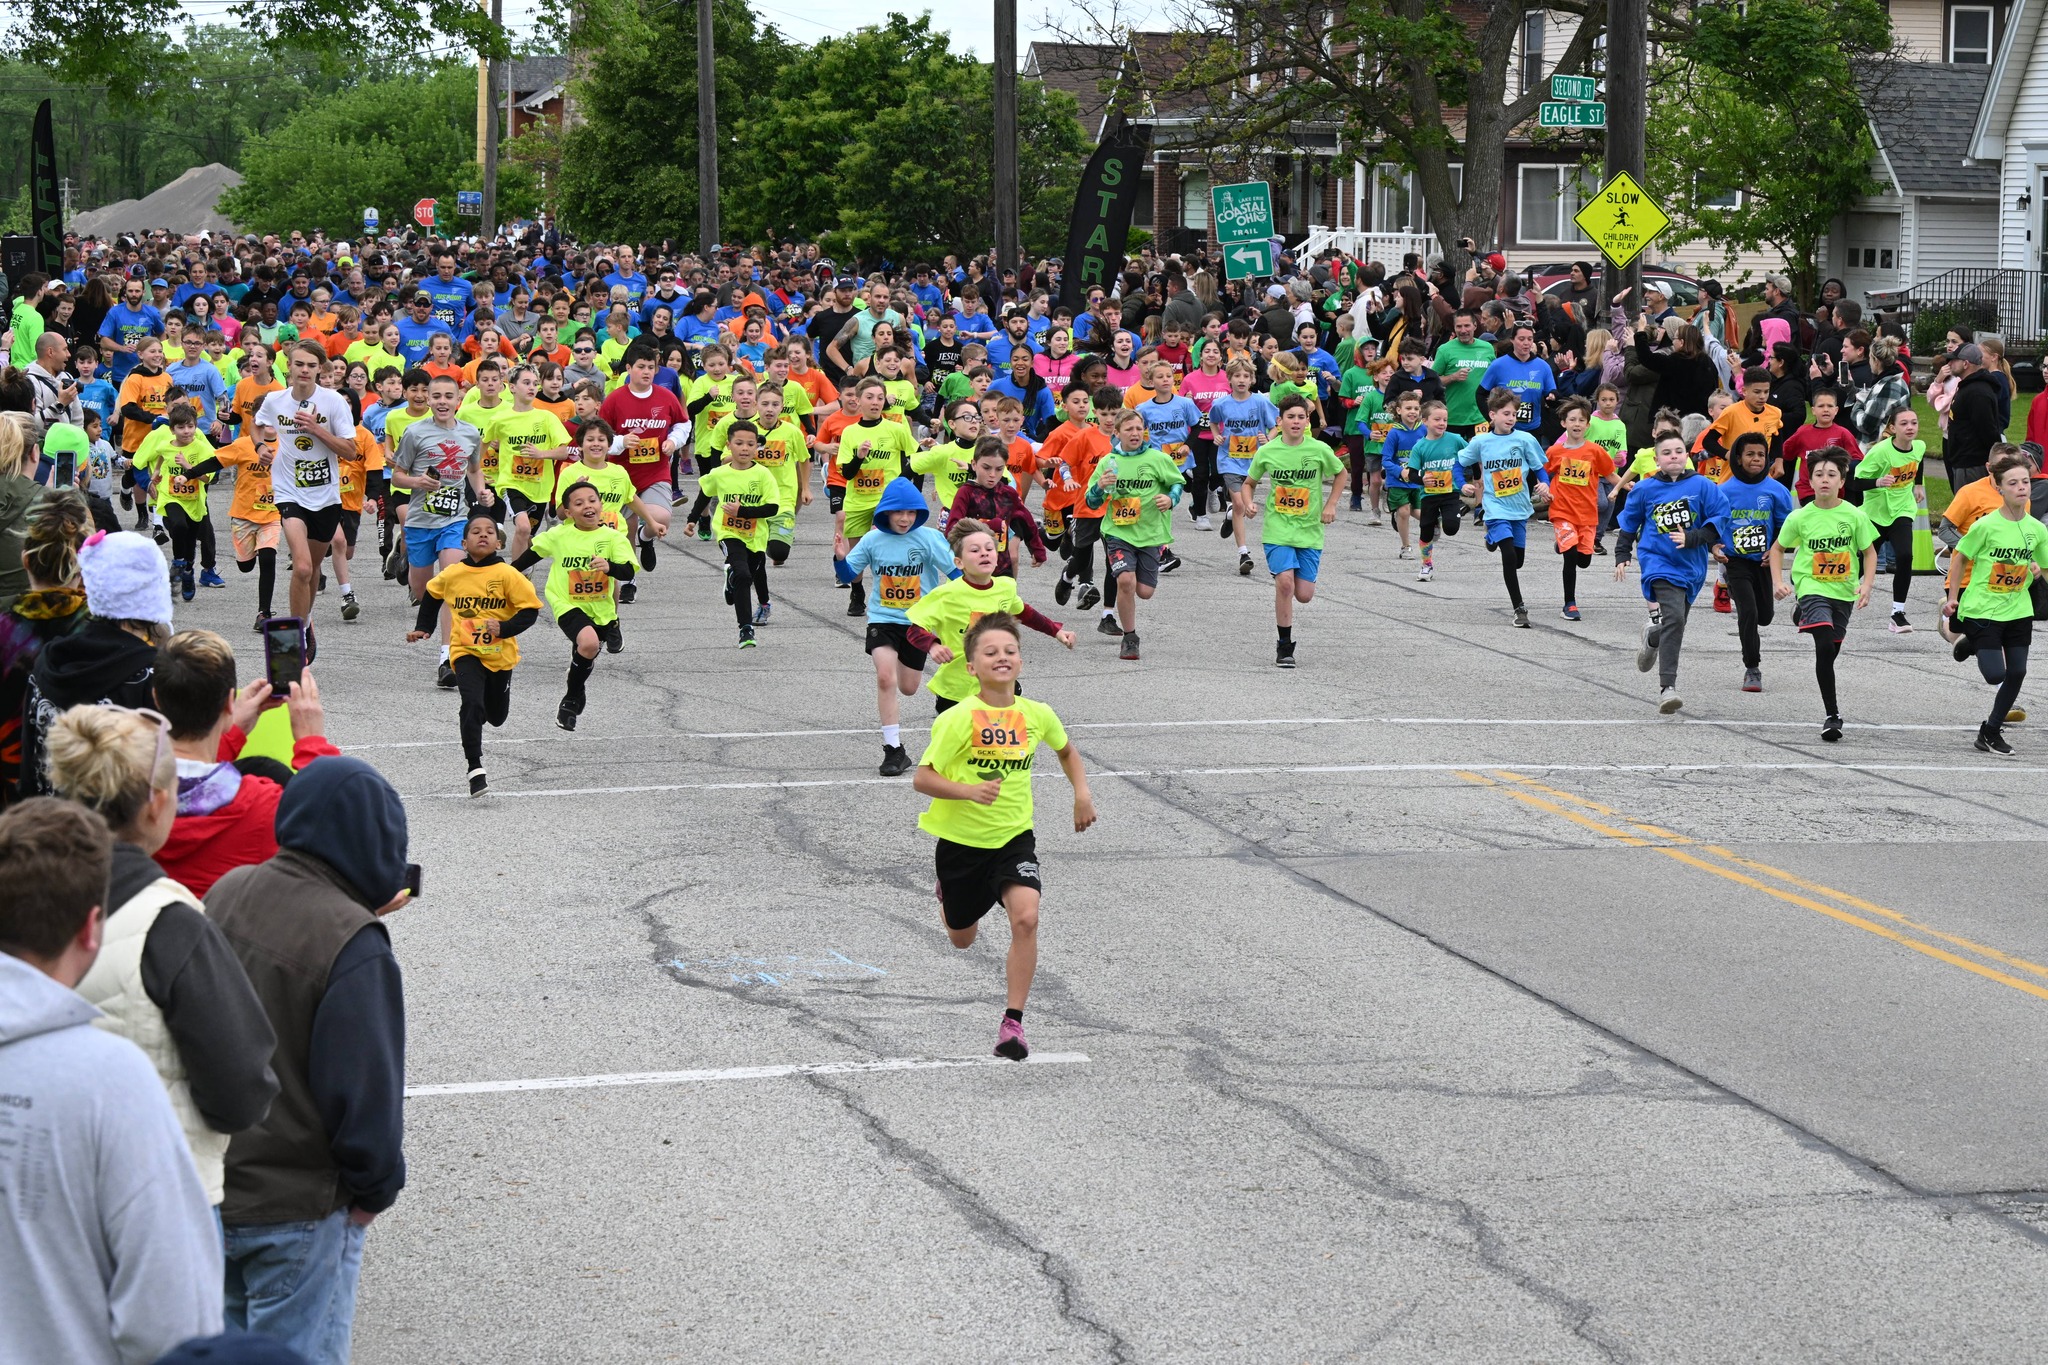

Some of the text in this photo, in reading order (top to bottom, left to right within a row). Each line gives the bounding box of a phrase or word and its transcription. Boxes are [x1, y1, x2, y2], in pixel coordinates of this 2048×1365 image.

[1555, 79, 1592, 98] SECOND ST
[1544, 106, 1600, 123] EAGLE ST
[1606, 192, 1640, 204] SLOW
[36, 142, 62, 274] TART
[416, 207, 433, 218] STO
[1217, 201, 1266, 223] COASTAL
[1080, 158, 1123, 295] STAR
[1232, 228, 1258, 236] TRAIL
[1603, 233, 1639, 242] CHILDREN
[1605, 241, 1636, 250] AT PLAY
[937, 352, 960, 361] JESUS
[1474, 360, 1488, 368] RUN
[241, 401, 254, 409] JUS
[621, 419, 666, 428] JUST RUN
[1150, 421, 1185, 430] JUST RUN
[1200, 418, 1210, 426] 23
[1225, 420, 1260, 428] JUST RUN
[508, 434, 546, 445] JUST RUN
[634, 447, 655, 456] 193
[1236, 444, 1249, 453] 21
[757, 450, 781, 459] 863
[873, 450, 890, 460] RUN
[516, 465, 539, 475] 921
[1423, 460, 1441, 469] JUST
[1484, 459, 1522, 470] JUST RUN
[298, 468, 330, 480] 2623
[1272, 469, 1317, 479] JUST RUN
[1564, 468, 1586, 479] 314
[1894, 472, 1914, 483] 782
[858, 478, 880, 487] 906
[1133, 480, 1153, 489] RUN
[1498, 478, 1519, 489] 626
[174, 485, 195, 493] 939
[427, 494, 458, 510] 2356
[1280, 497, 1304, 508] 459
[1657, 502, 1684, 513] GCXC
[1116, 508, 1136, 517] 464
[727, 517, 751, 530] 856
[1657, 510, 1690, 527] 2669
[1737, 527, 1762, 535] GCXC
[1735, 535, 1766, 548] 2282
[1808, 539, 1831, 550] JUST
[1990, 548, 2017, 559] JUST
[562, 557, 588, 568] JUST
[875, 562, 923, 577] JUST RUN
[1818, 564, 1846, 574] 778
[1996, 574, 2022, 585] 764
[575, 582, 603, 593] 855
[886, 588, 915, 600] 605
[452, 597, 506, 609] JUST RUN
[472, 633, 492, 644] 79
[981, 728, 1020, 745] 991
